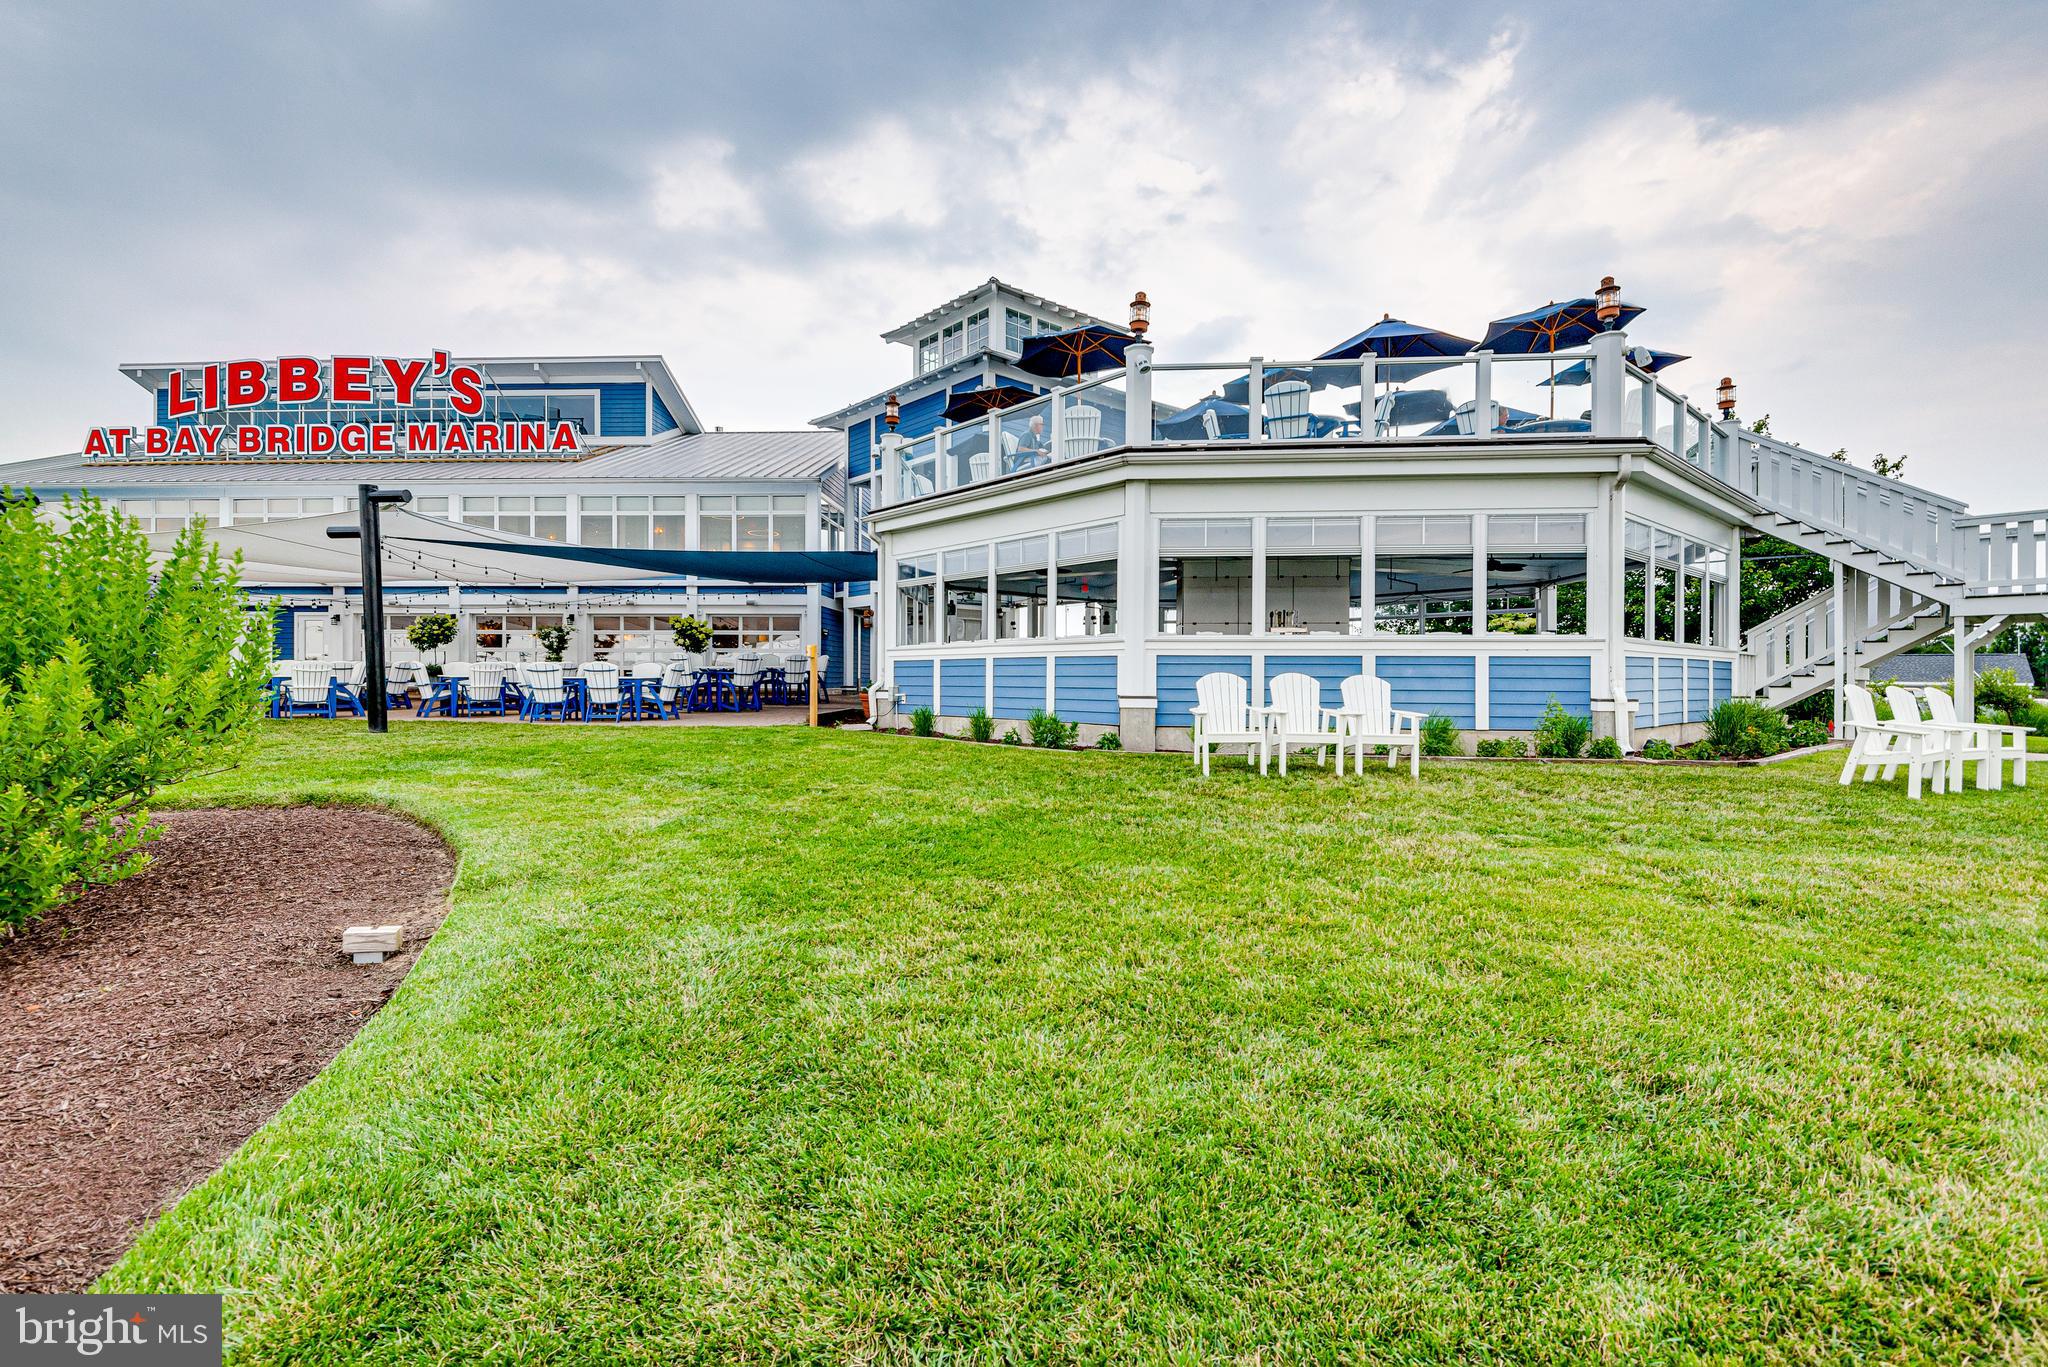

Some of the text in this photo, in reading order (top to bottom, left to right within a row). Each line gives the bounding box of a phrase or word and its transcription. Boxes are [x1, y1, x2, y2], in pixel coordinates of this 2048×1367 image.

[167, 349, 486, 418] LIBBEY'S
[81, 422, 582, 457] AT BAY BRIDGE MARINA
